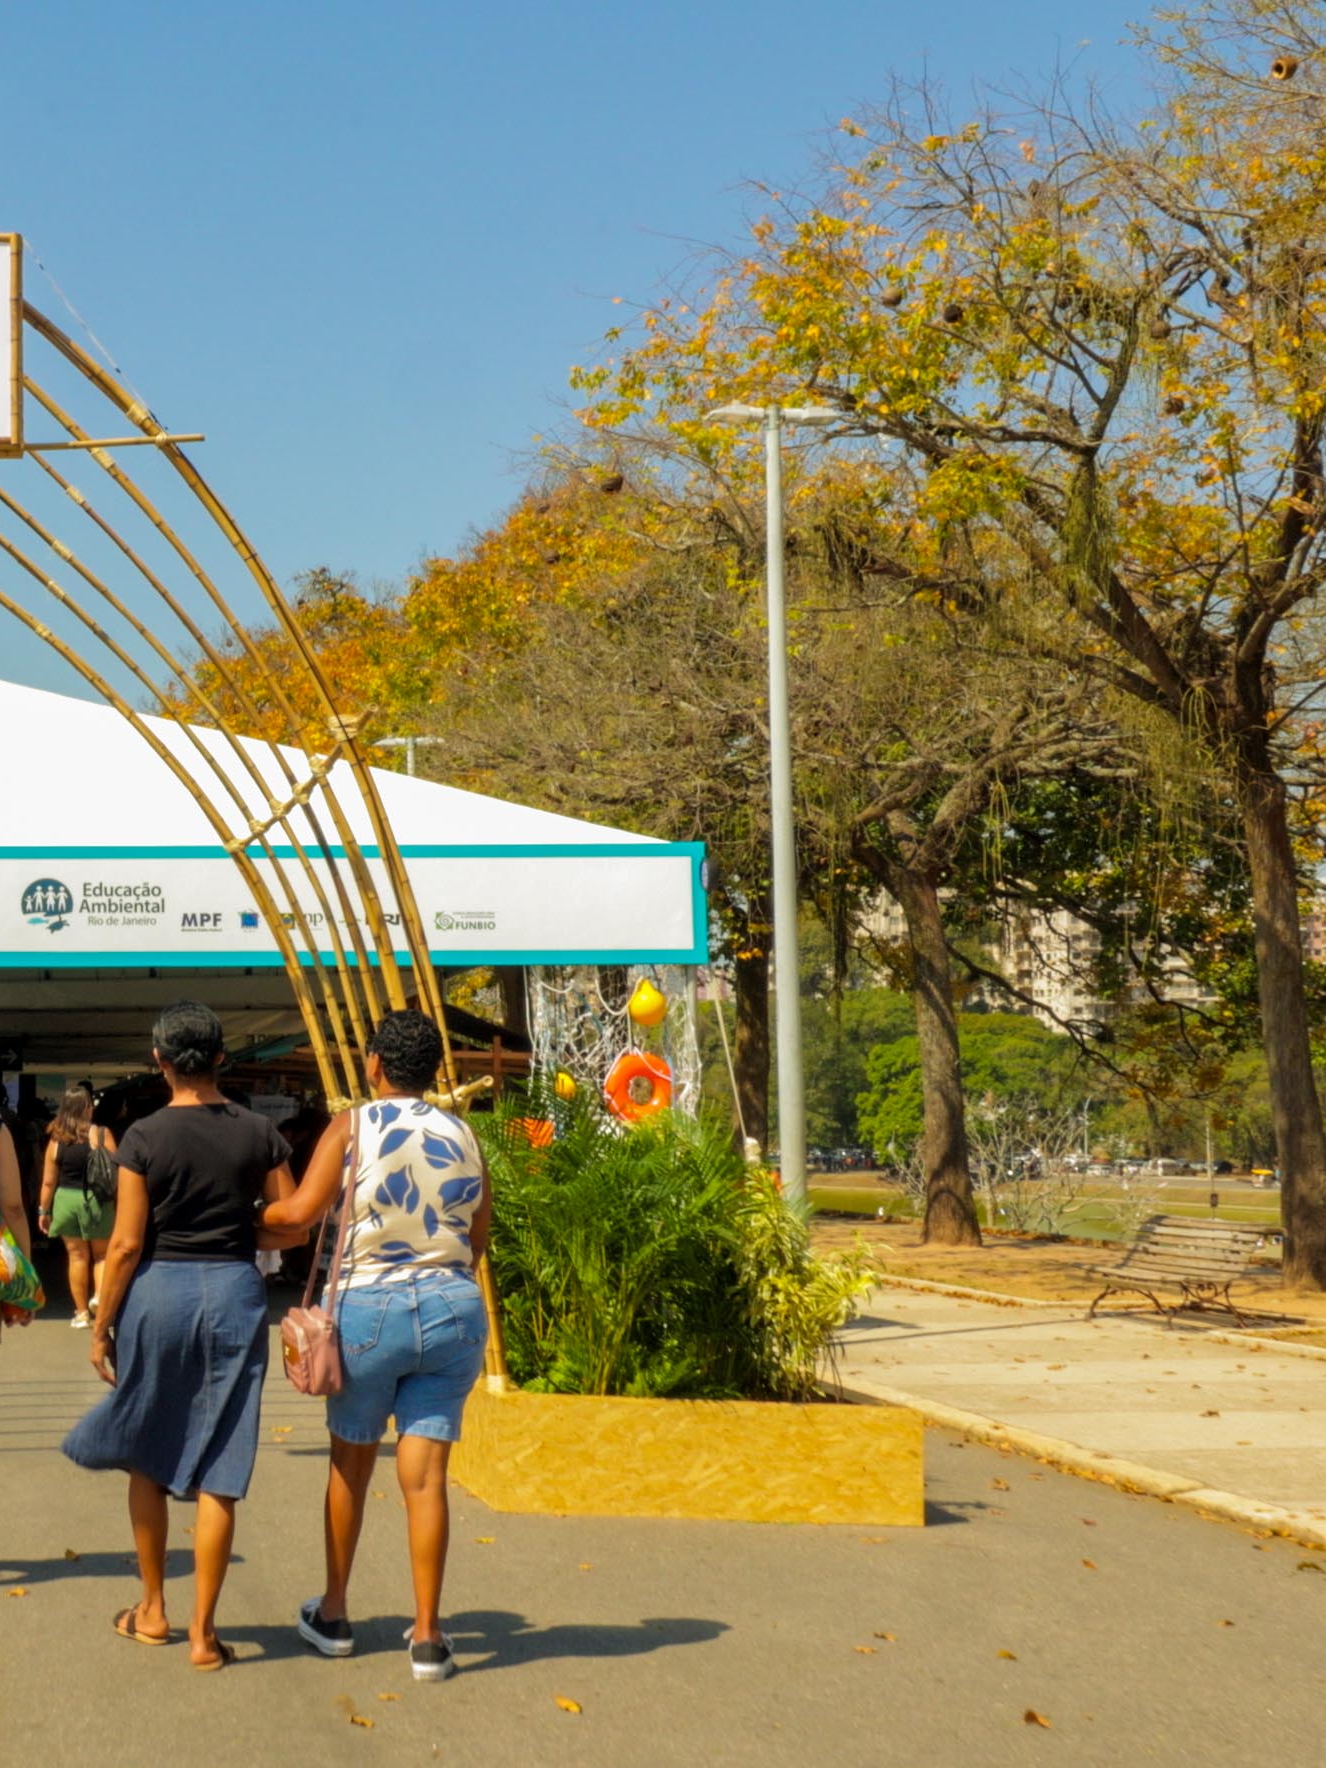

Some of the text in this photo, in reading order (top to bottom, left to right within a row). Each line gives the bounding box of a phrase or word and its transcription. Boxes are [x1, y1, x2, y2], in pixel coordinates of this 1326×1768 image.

[82, 881, 162, 901] Educação
[78, 898, 166, 914] Ambiental
[88, 915, 158, 926] Rio de Janeiro
[181, 912, 223, 927] MPF
[455, 920, 496, 930] FUNBIO
